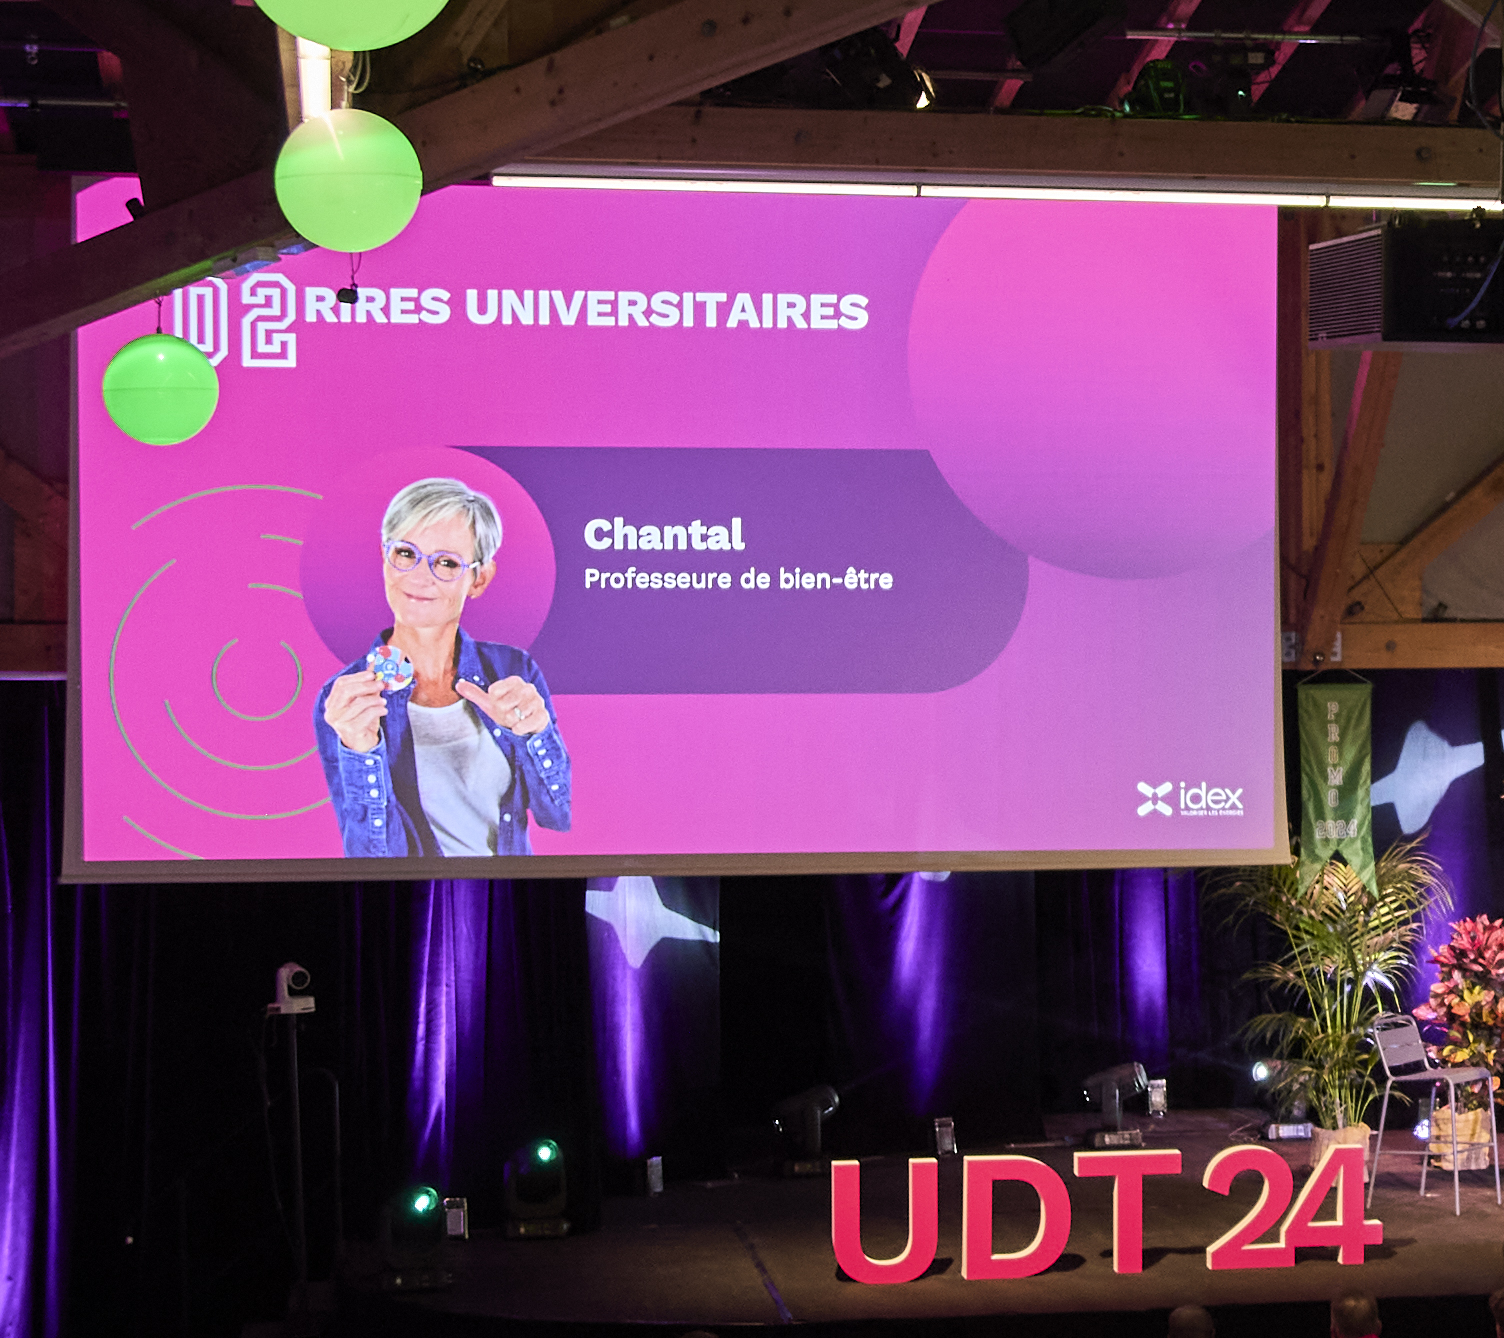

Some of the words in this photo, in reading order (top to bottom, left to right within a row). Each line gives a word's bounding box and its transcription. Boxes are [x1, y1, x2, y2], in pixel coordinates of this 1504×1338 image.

[305, 286, 451, 324] RIRES
[466, 288, 869, 329] UNIVERSITAIRES
[584, 516, 745, 550] Chantal
[584, 567, 731, 589] Professeure
[739, 567, 771, 589] de
[779, 566, 894, 590] bien-être
[1179, 781, 1244, 809] idex
[1315, 819, 1358, 839] 2024
[831, 1149, 1182, 1285] UDT
[1202, 1144, 1384, 1271] 24
